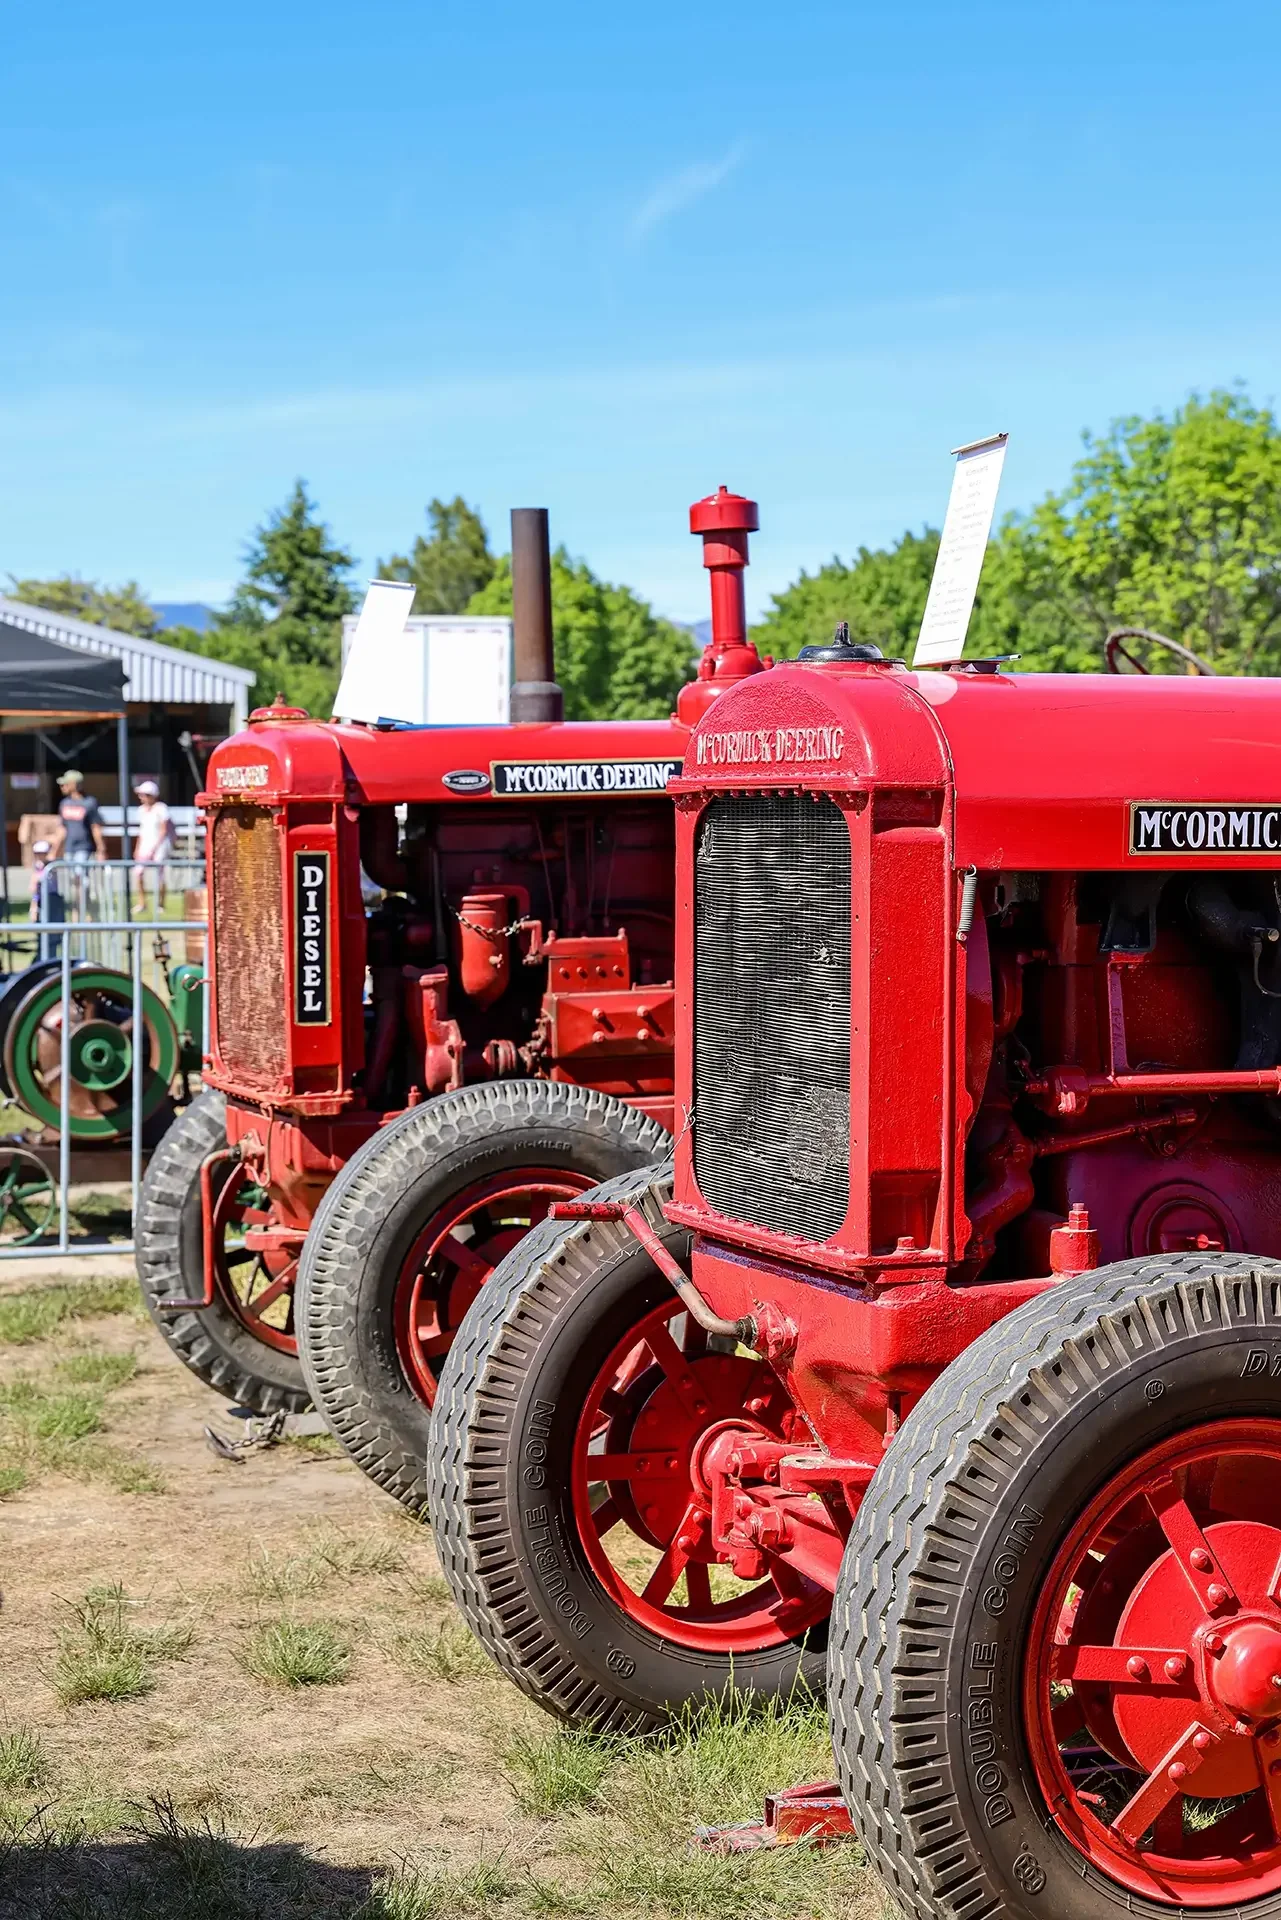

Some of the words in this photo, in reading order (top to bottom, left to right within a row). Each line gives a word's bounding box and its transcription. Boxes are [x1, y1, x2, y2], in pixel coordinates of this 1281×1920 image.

[1137, 810, 1281, 849] McCORMIC
[301, 865, 324, 1012] DIESEL
[522, 1399, 556, 1491] COIN
[525, 1503, 595, 1641] DOUBLE
[982, 1503, 1045, 1617] COIN
[967, 1641, 1013, 1829] DOUBLE
